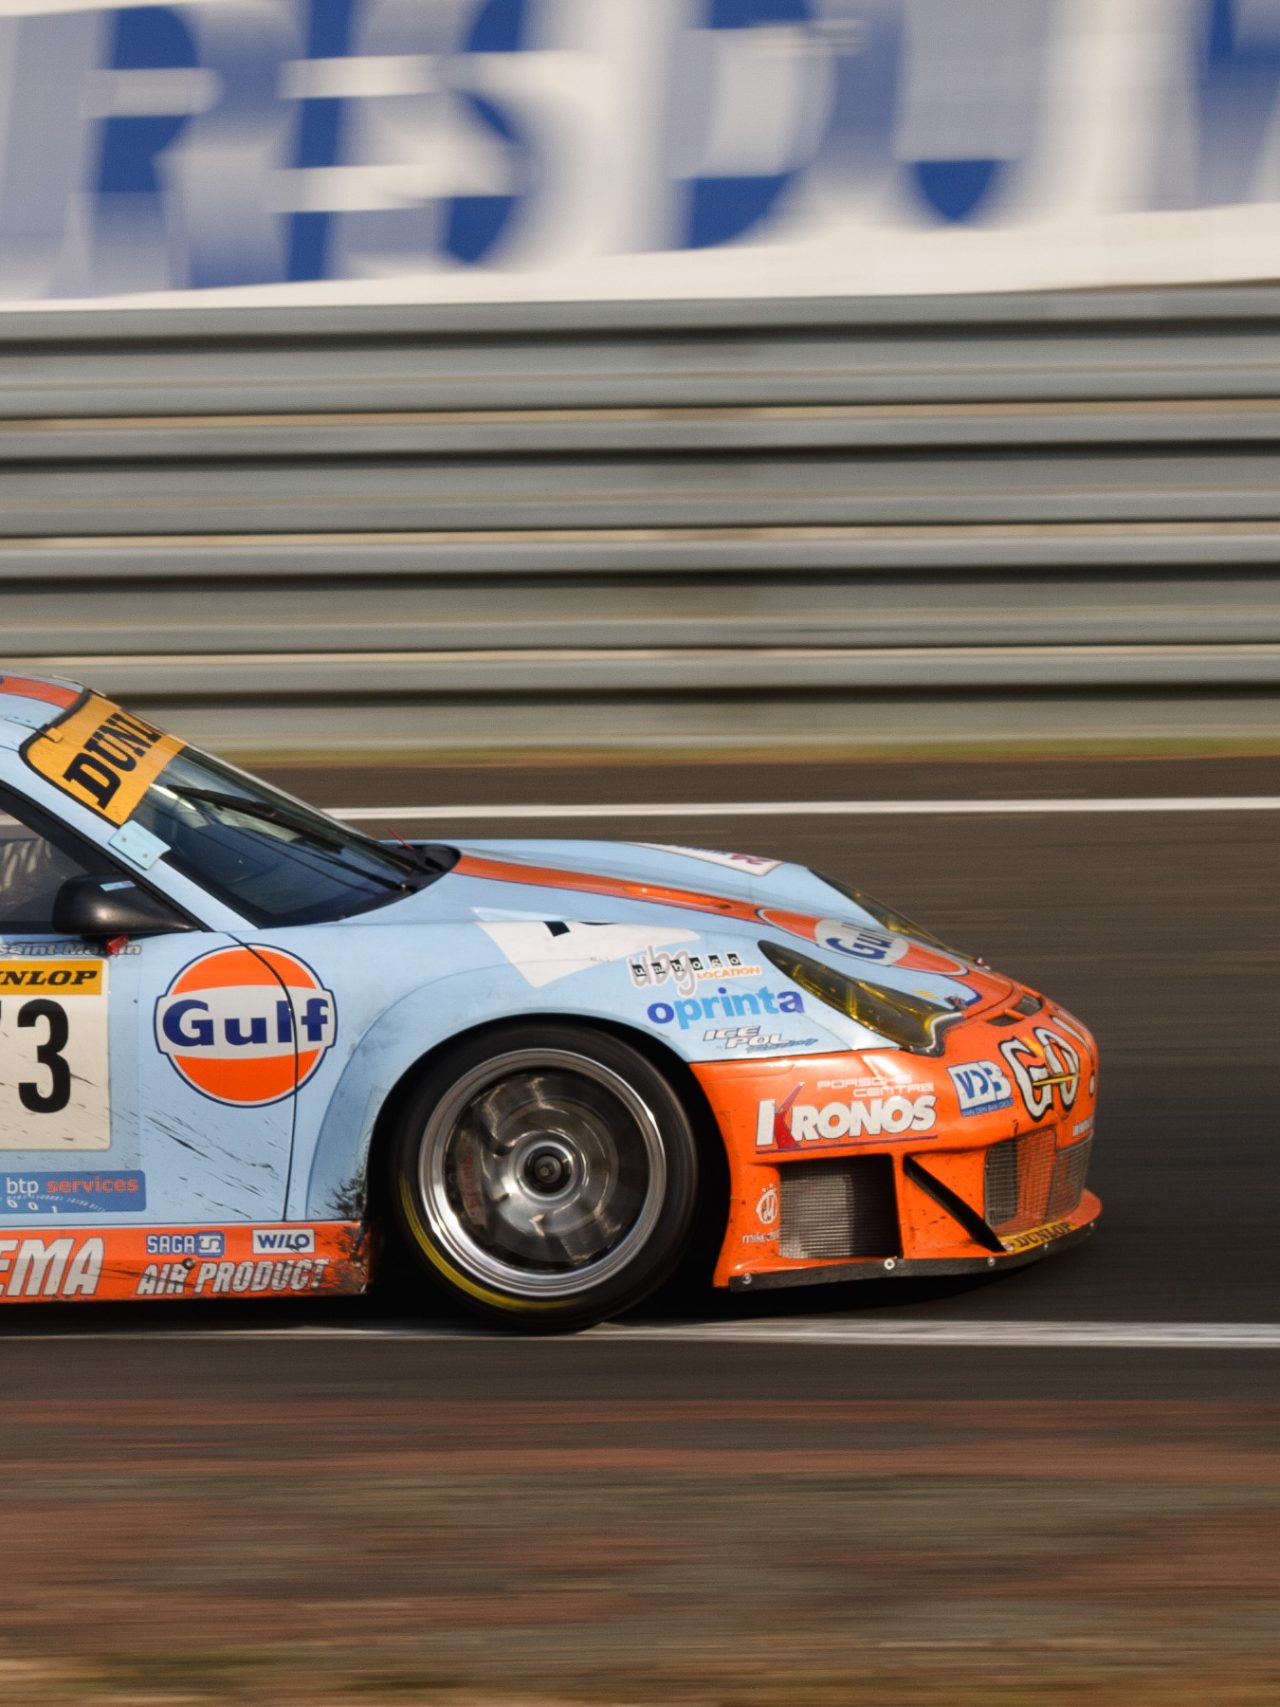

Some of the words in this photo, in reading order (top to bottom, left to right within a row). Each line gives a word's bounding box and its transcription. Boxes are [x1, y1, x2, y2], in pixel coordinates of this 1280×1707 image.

[696, 967, 761, 979] LOCATION
[647, 986, 805, 1030] oprinta
[162, 997, 329, 1047] Gulf
[703, 1025, 761, 1041] ICE
[725, 1034, 789, 1049] POL
[817, 1074, 912, 1090] PORSCHE
[853, 1082, 934, 1098] CENTRE
[756, 1083, 937, 1148] KRONOS
[6, 1177, 39, 1198] btp
[46, 1176, 139, 1193] services
[146, 1235, 196, 1254] SAGA
[258, 1234, 311, 1249] WILO
[136, 1262, 191, 1295] AIR
[195, 1258, 330, 1293] PRODUCT
